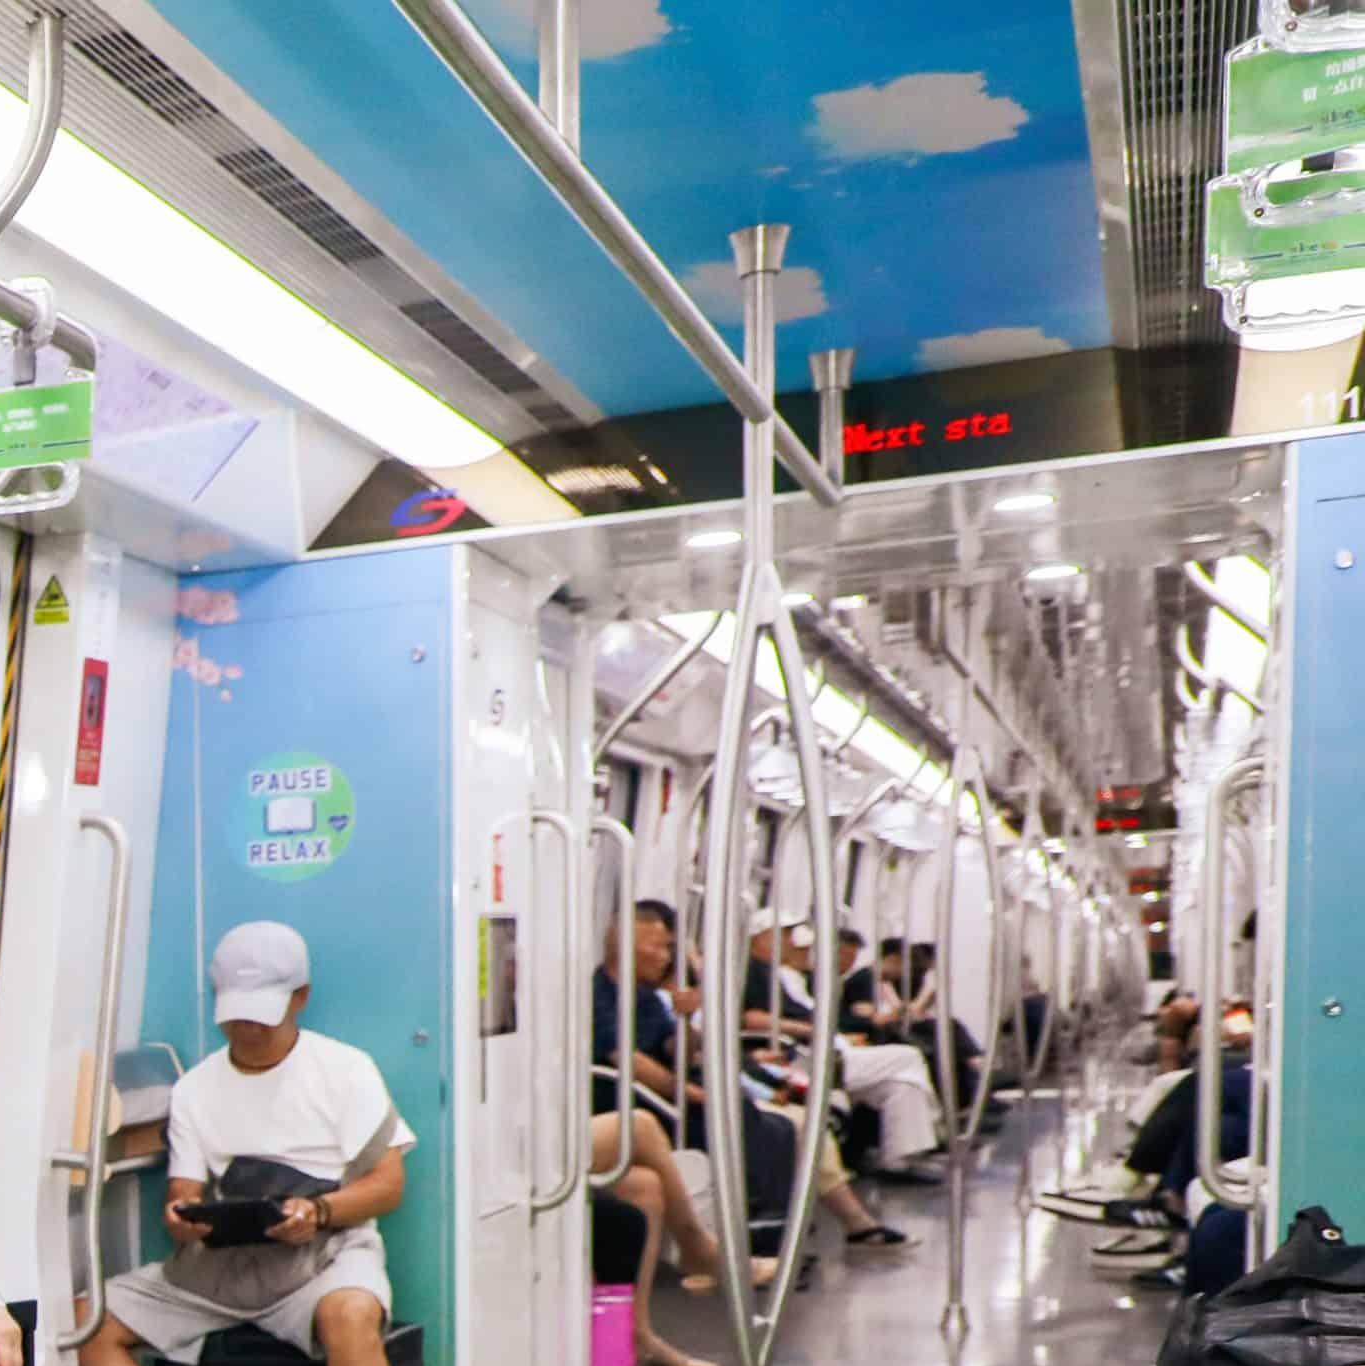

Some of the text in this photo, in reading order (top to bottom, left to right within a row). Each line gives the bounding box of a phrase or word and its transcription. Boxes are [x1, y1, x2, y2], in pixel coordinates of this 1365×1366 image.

[843, 413, 1011, 454] Next sta
[251, 767, 328, 792] PAUSE
[249, 839, 326, 863] RELAX
